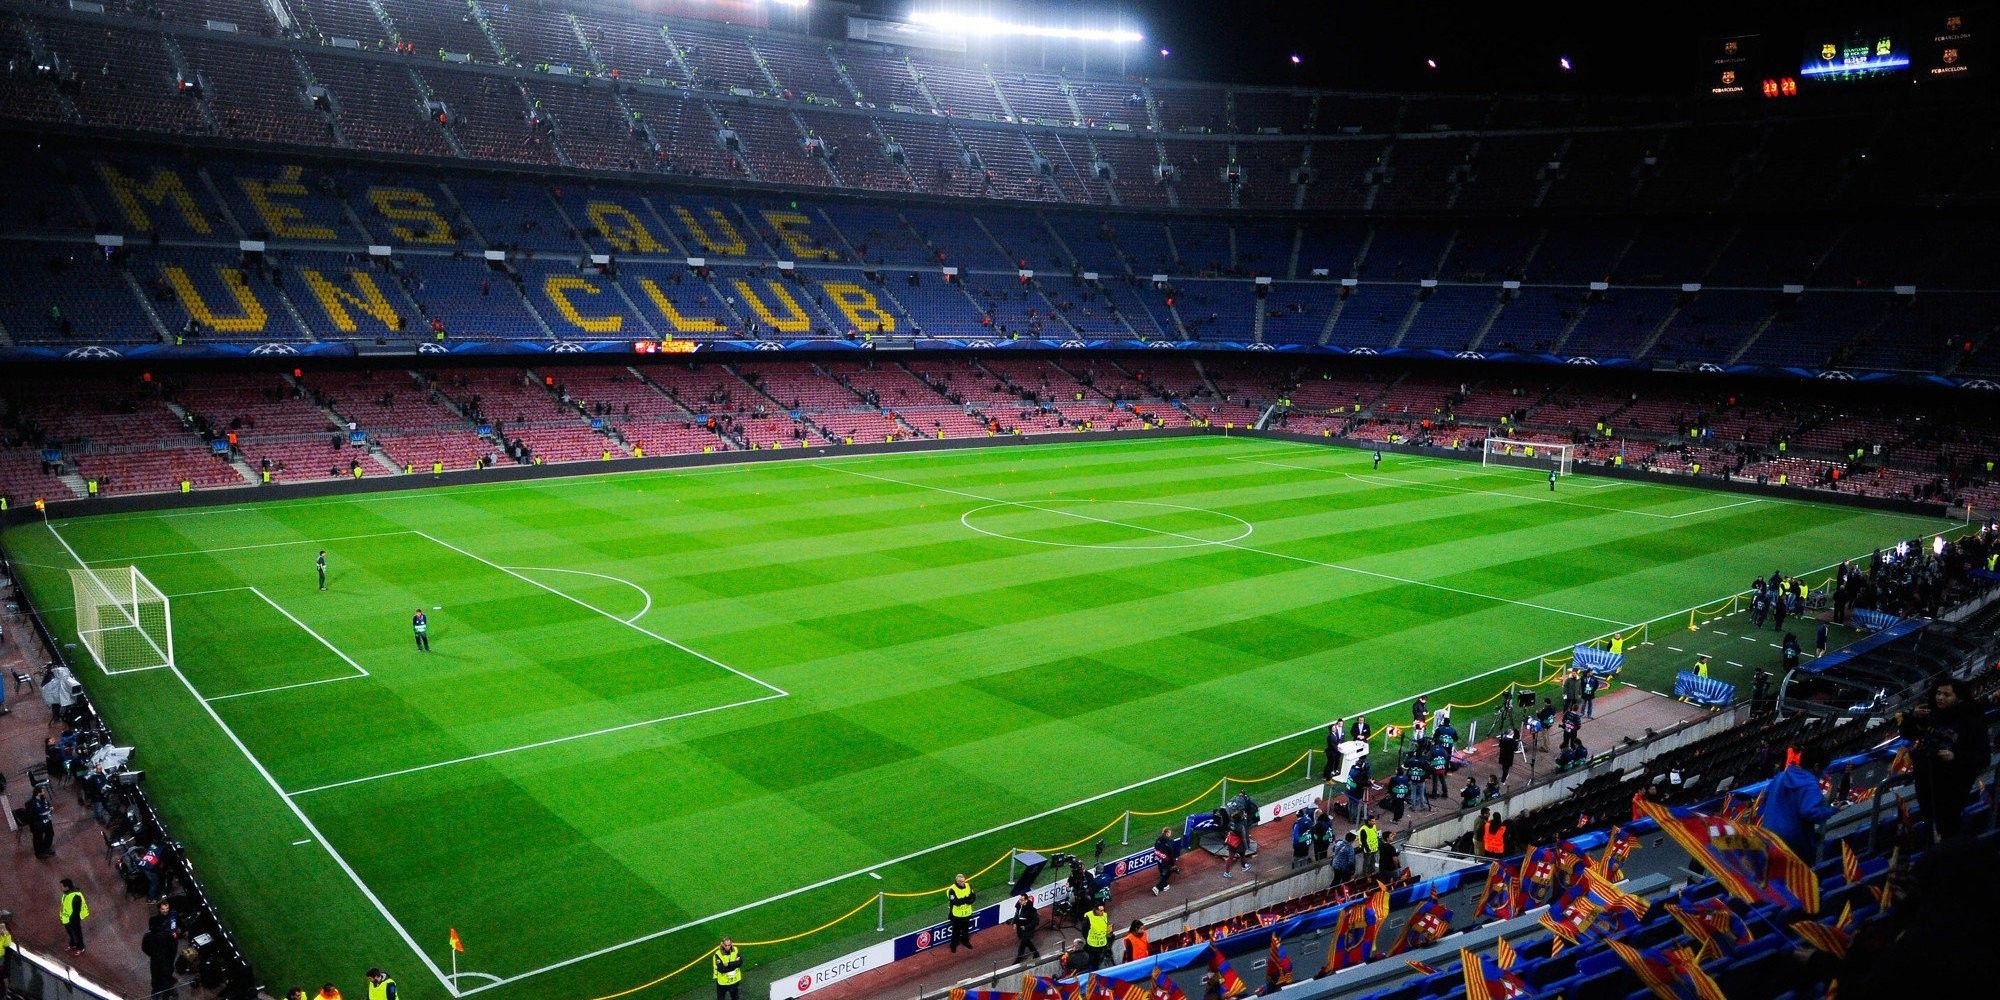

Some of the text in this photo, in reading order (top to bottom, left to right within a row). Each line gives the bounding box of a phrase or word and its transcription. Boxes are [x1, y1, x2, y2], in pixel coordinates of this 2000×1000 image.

[98, 163, 457, 245] MÉS
[585, 200, 841, 260] QUE
[161, 265, 401, 333] UN
[544, 274, 896, 333] CLUB
[1282, 793, 1312, 812] RESPECT
[1128, 852, 1155, 871] RESPE
[933, 916, 980, 942] REST
[815, 955, 868, 984] RESPECT
